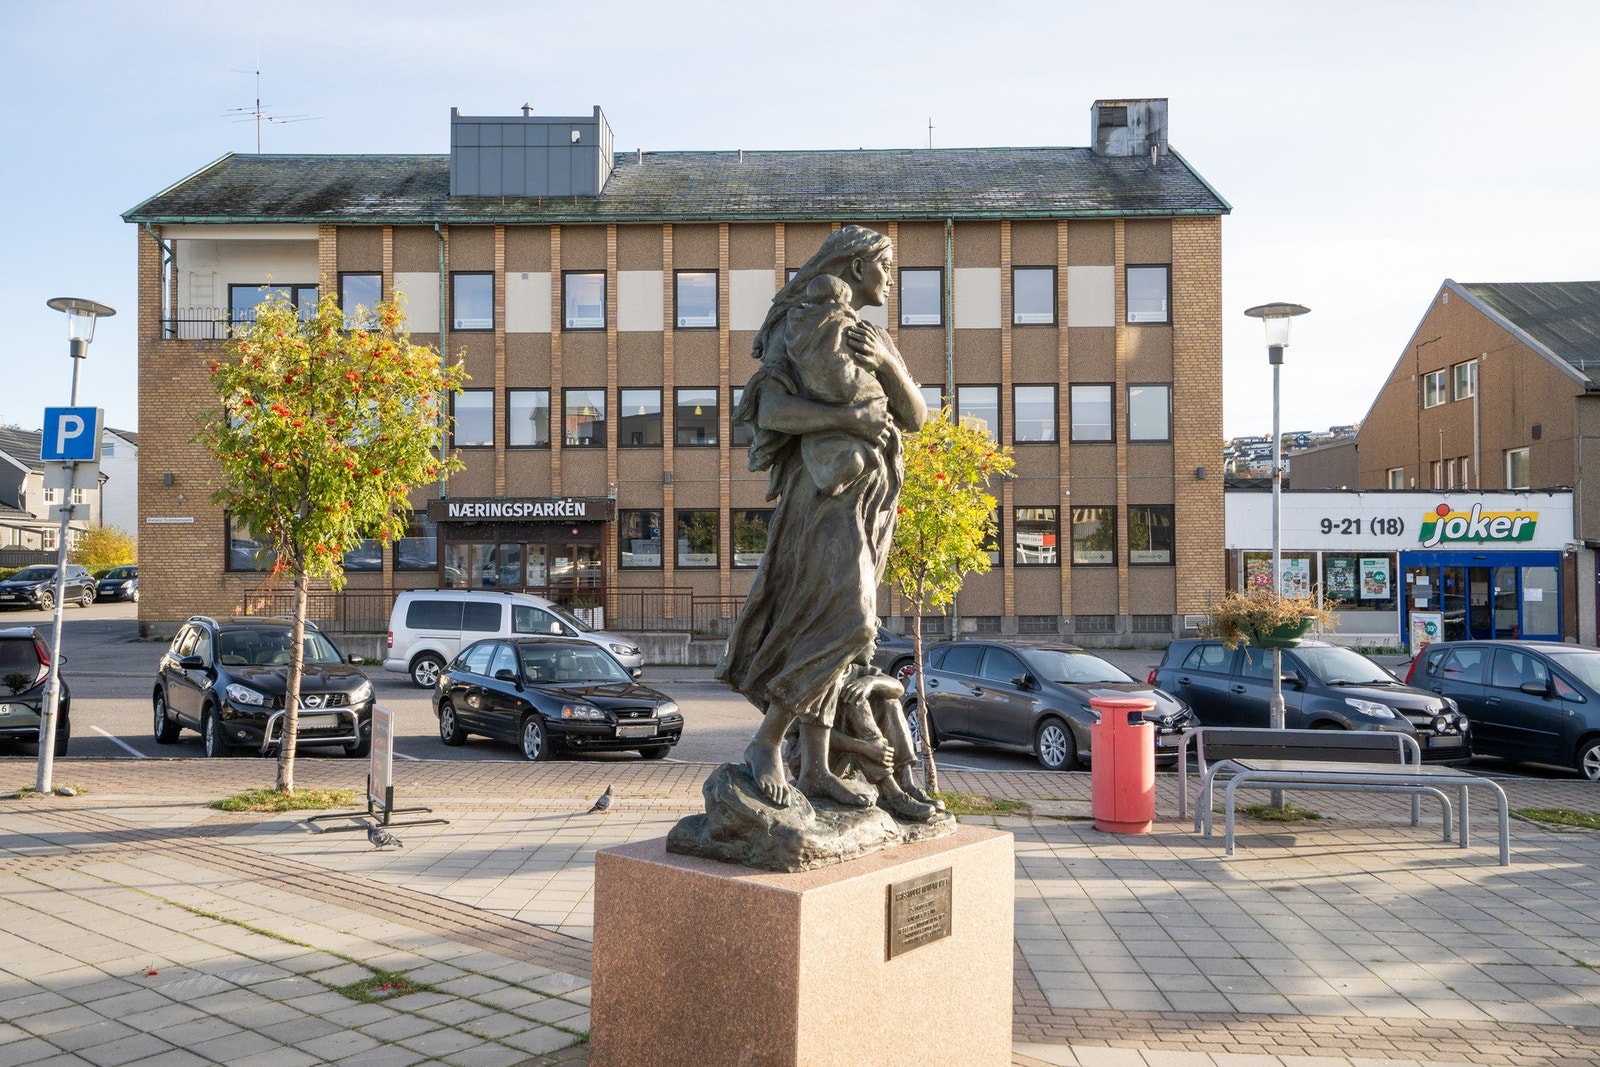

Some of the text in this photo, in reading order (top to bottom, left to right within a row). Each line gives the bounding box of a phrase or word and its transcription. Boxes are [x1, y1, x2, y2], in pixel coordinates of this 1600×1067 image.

[56, 414, 85, 454] P
[1320, 516, 1405, 536] 9-21 (18)
[1423, 502, 1531, 548] joker
[1, 703, 7, 713] 6
